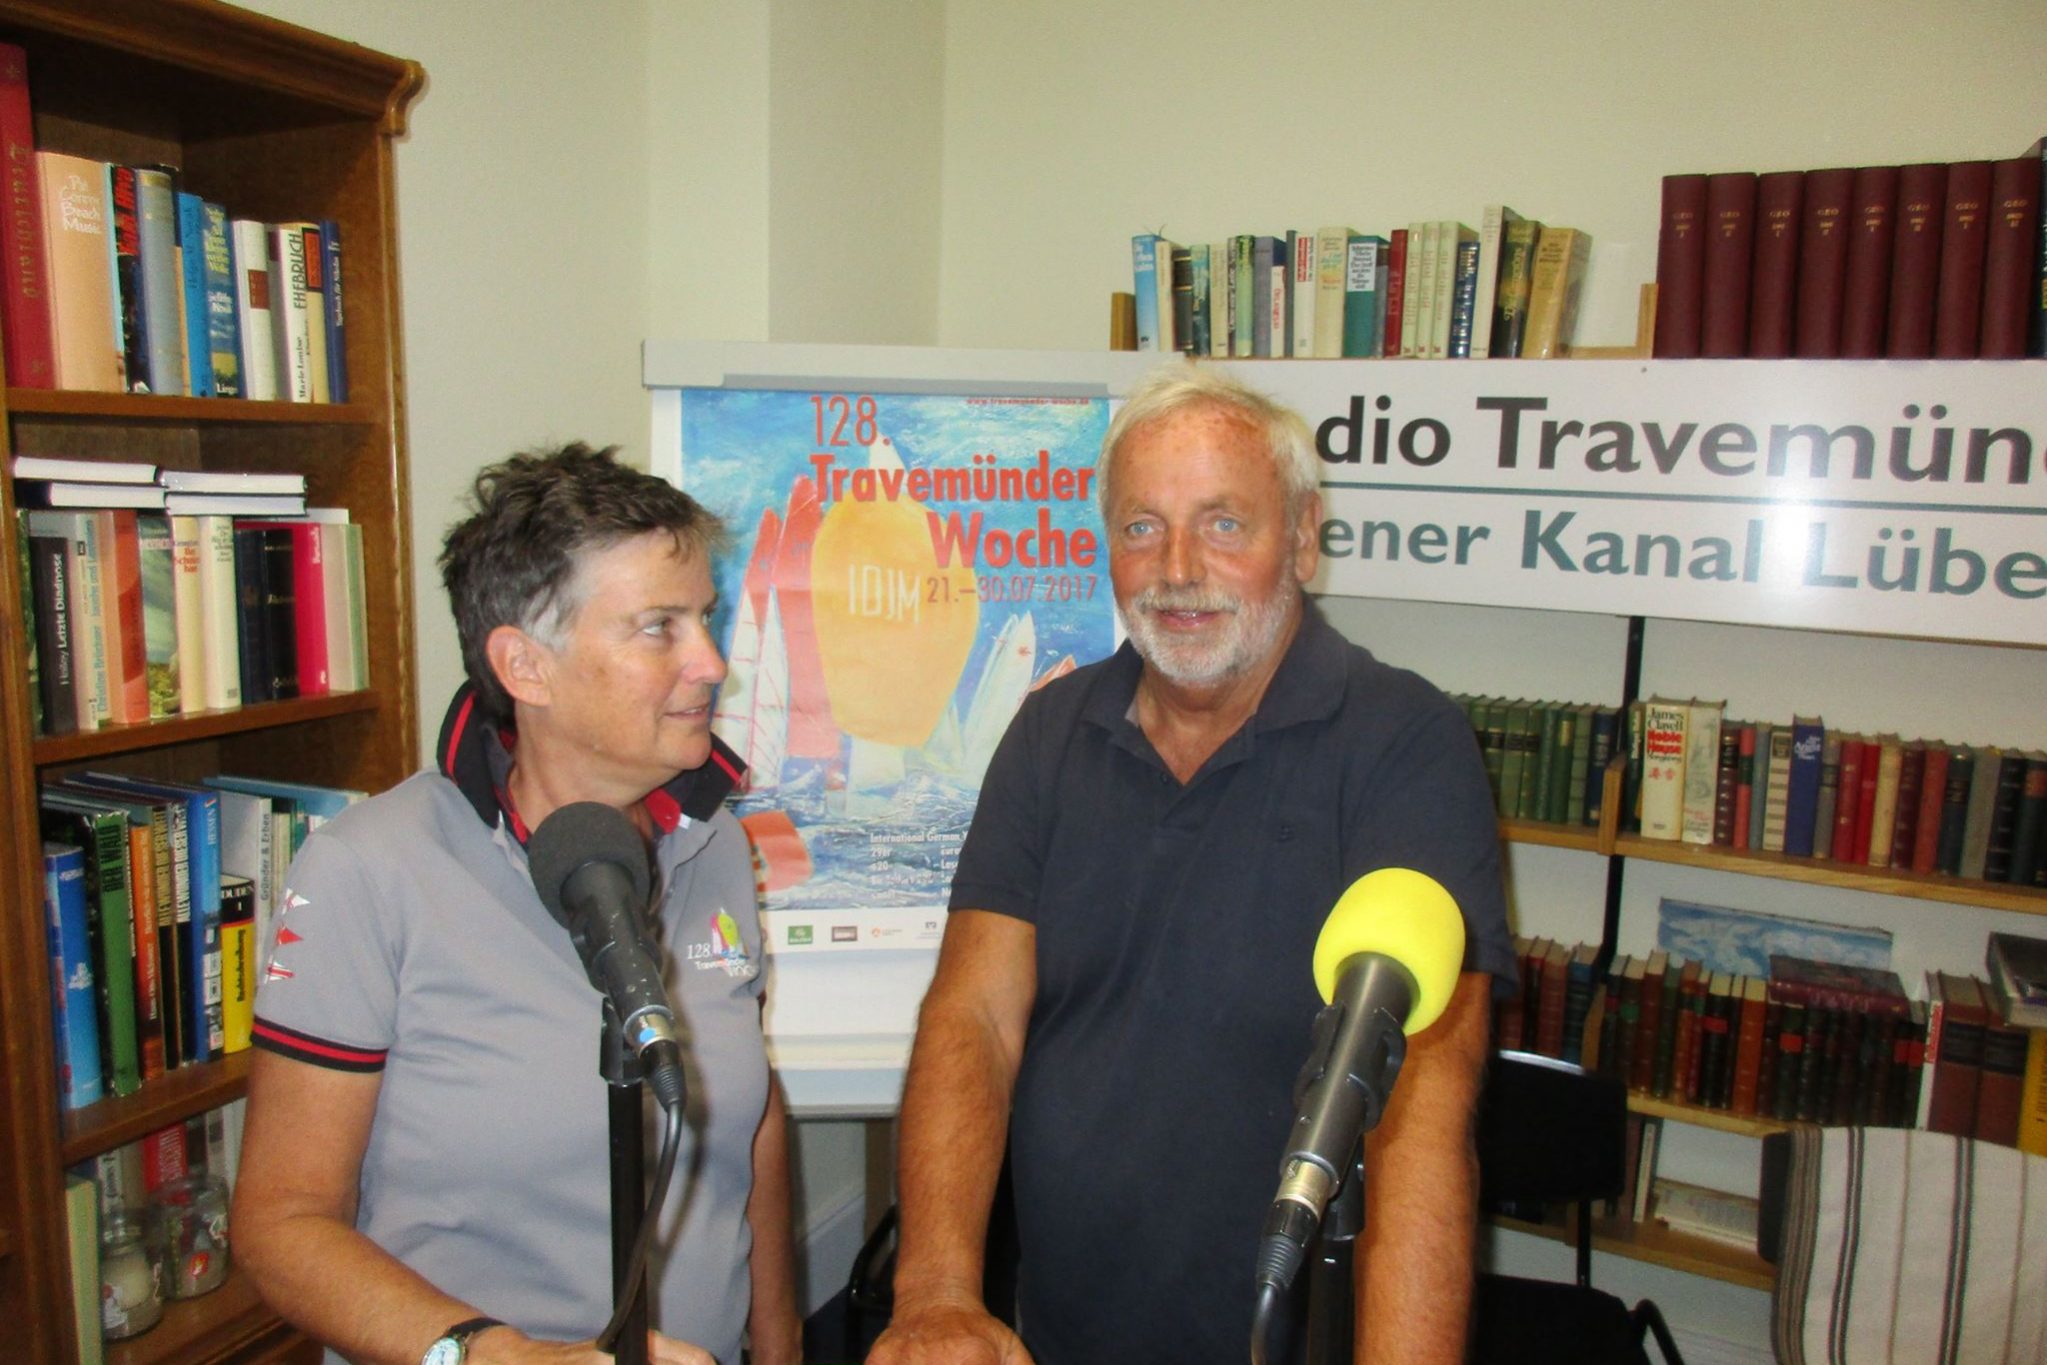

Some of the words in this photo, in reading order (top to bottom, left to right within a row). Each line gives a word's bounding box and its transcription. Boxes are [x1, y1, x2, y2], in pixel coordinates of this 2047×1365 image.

[290, 232, 308, 311] EHEBRUCH
[810, 394, 891, 447] 128.
[1316, 394, 1452, 467] dio
[1476, 396, 2047, 486] Travemün
[809, 450, 1096, 502] Travemünder
[926, 508, 1097, 569] Woche
[1318, 517, 1491, 566] ener
[1520, 509, 1764, 584] Kanal
[1648, 706, 1685, 720] James
[99, 823, 123, 865] WALD
[262, 812, 271, 843] Erben
[869, 831, 925, 843] International
[927, 831, 961, 843] German
[102, 865, 125, 893] DER
[261, 857, 271, 901] Gründer
